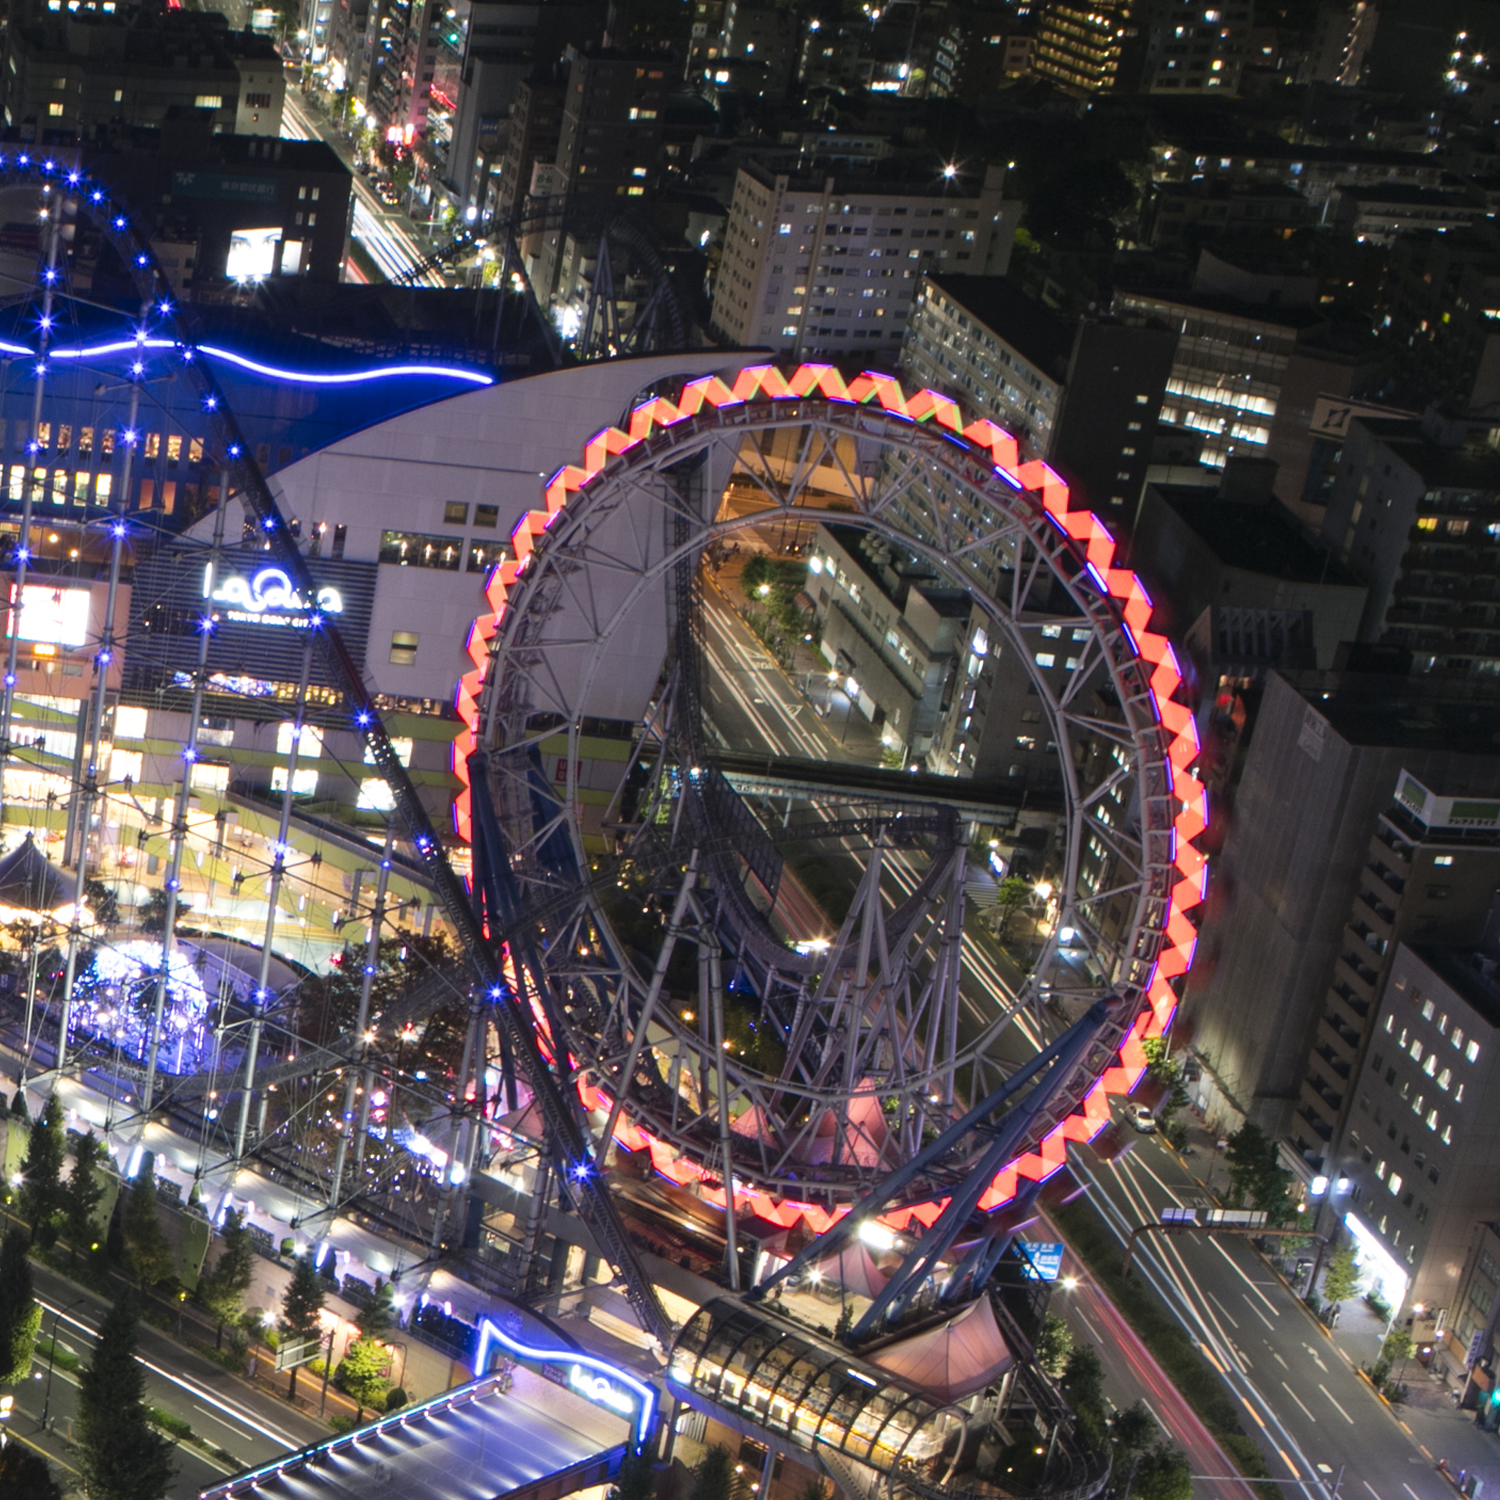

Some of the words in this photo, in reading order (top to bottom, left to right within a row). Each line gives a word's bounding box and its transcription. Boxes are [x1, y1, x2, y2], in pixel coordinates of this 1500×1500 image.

[1448, 818, 1497, 827] クレアスライフ
